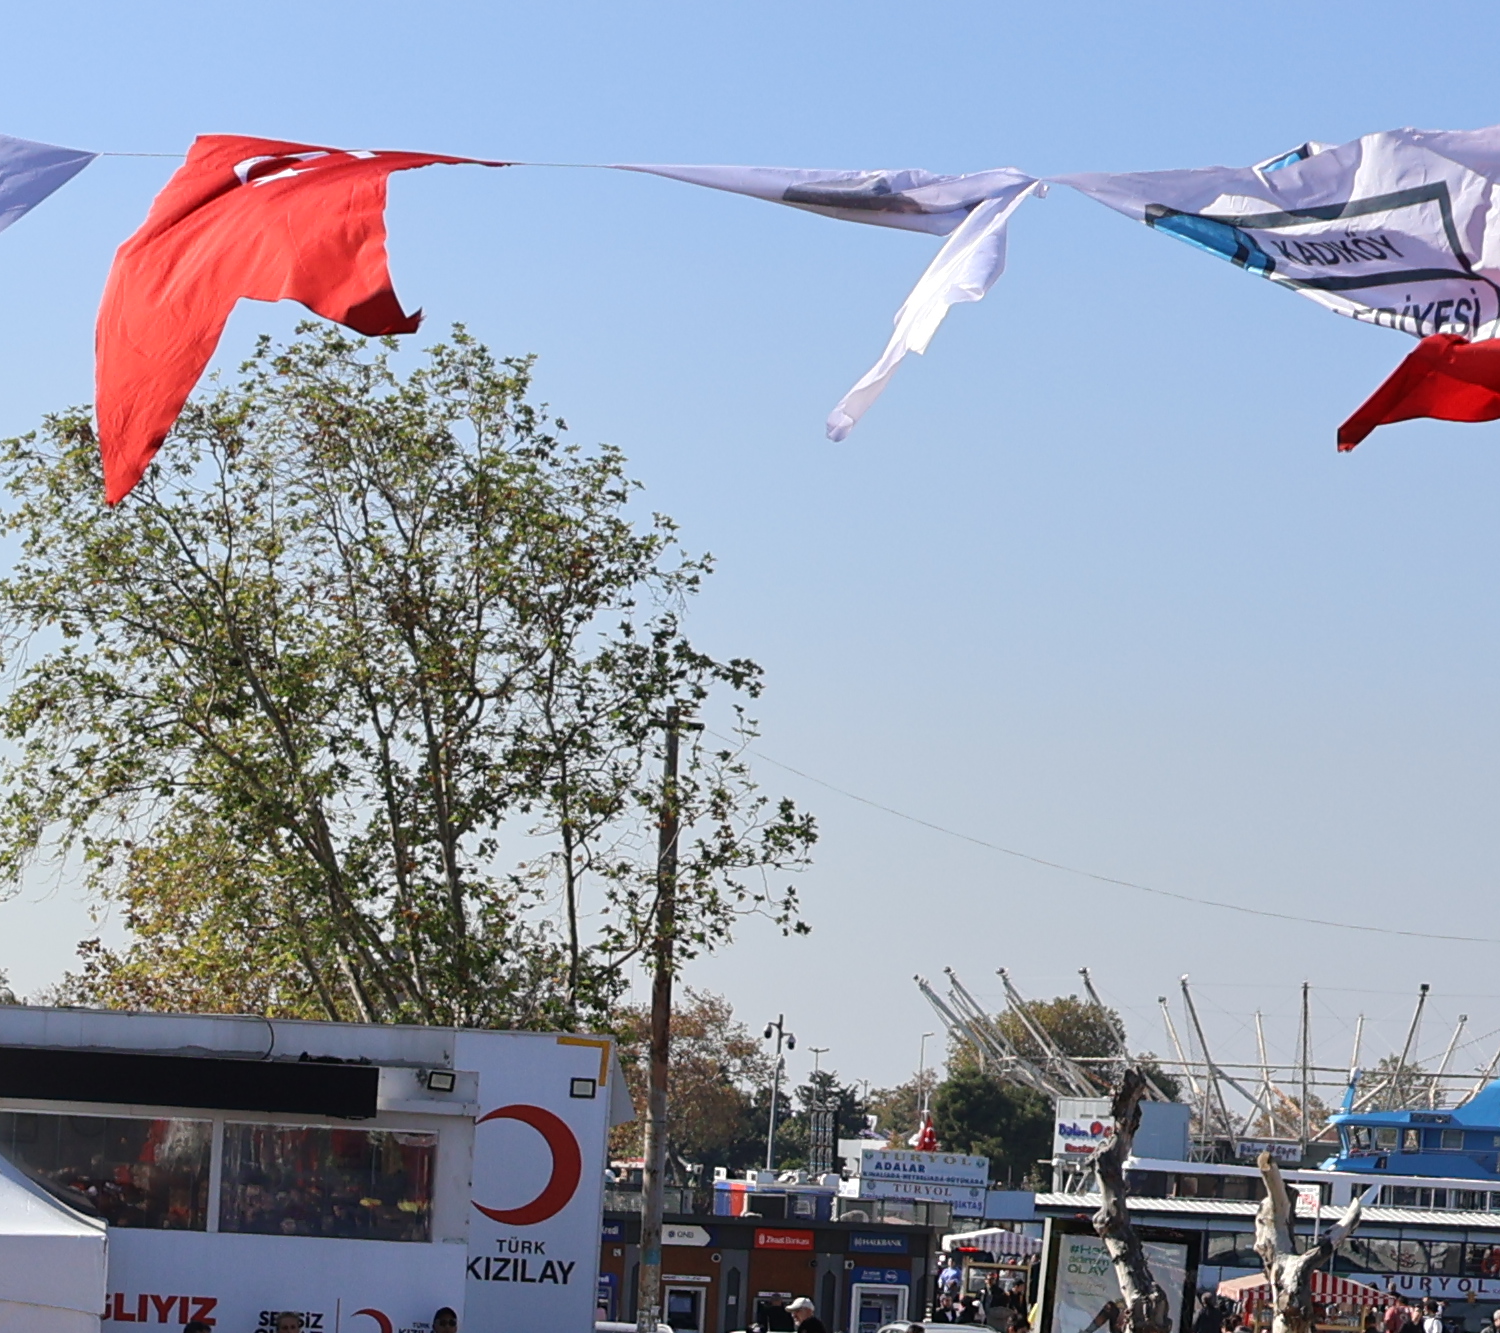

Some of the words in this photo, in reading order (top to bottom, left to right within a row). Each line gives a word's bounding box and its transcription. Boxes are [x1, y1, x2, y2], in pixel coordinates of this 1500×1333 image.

[1270, 231, 1405, 267] KADIKÖY
[874, 1161, 927, 1174] ADALAR
[893, 1183, 953, 1197] TURYOL
[496, 1236, 546, 1256] TÜRK
[466, 1256, 576, 1285] KIZILAY
[1067, 1263, 1109, 1276] OLAY
